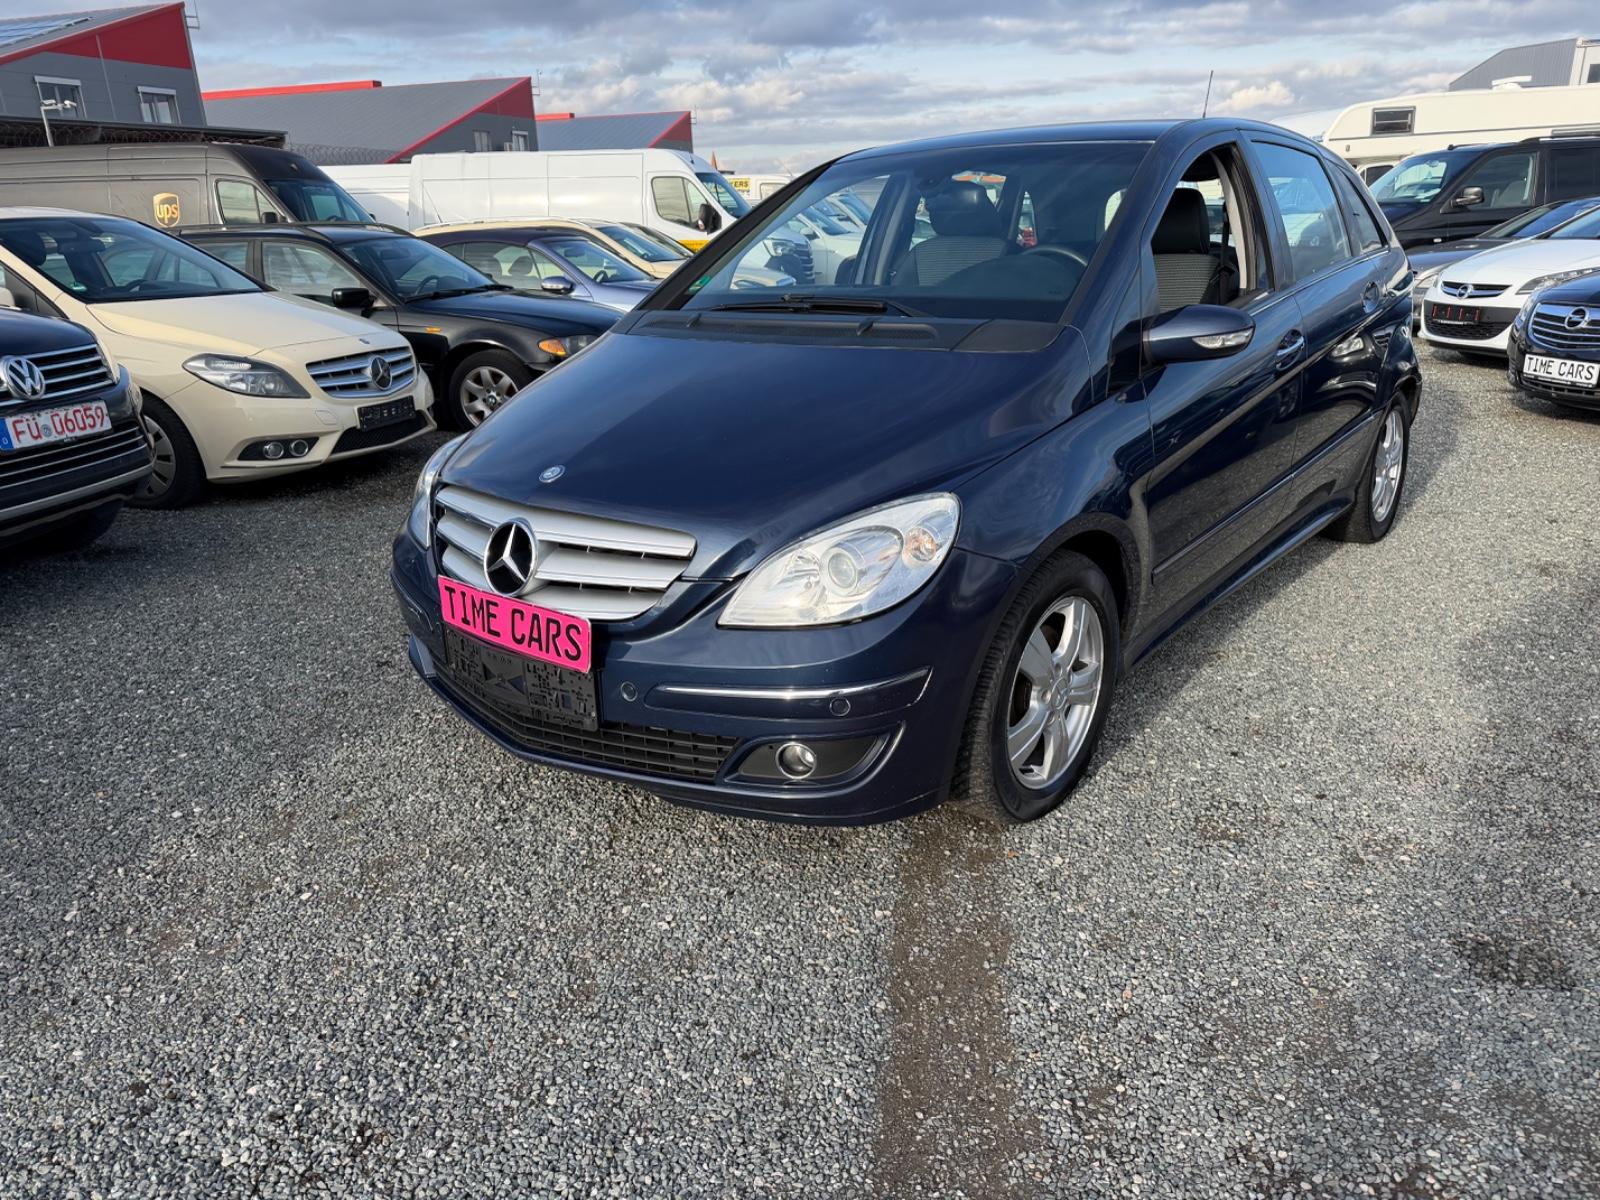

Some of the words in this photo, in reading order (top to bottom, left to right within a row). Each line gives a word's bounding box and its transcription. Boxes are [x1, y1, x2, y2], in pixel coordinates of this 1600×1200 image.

[157, 204, 178, 224] ups
[1527, 356, 1555, 375] TIME
[1557, 361, 1595, 381] CARS
[12, 416, 42, 444] FÜ
[50, 405, 105, 436] 06059
[444, 585, 501, 638] TIME
[511, 607, 582, 662] CARS
